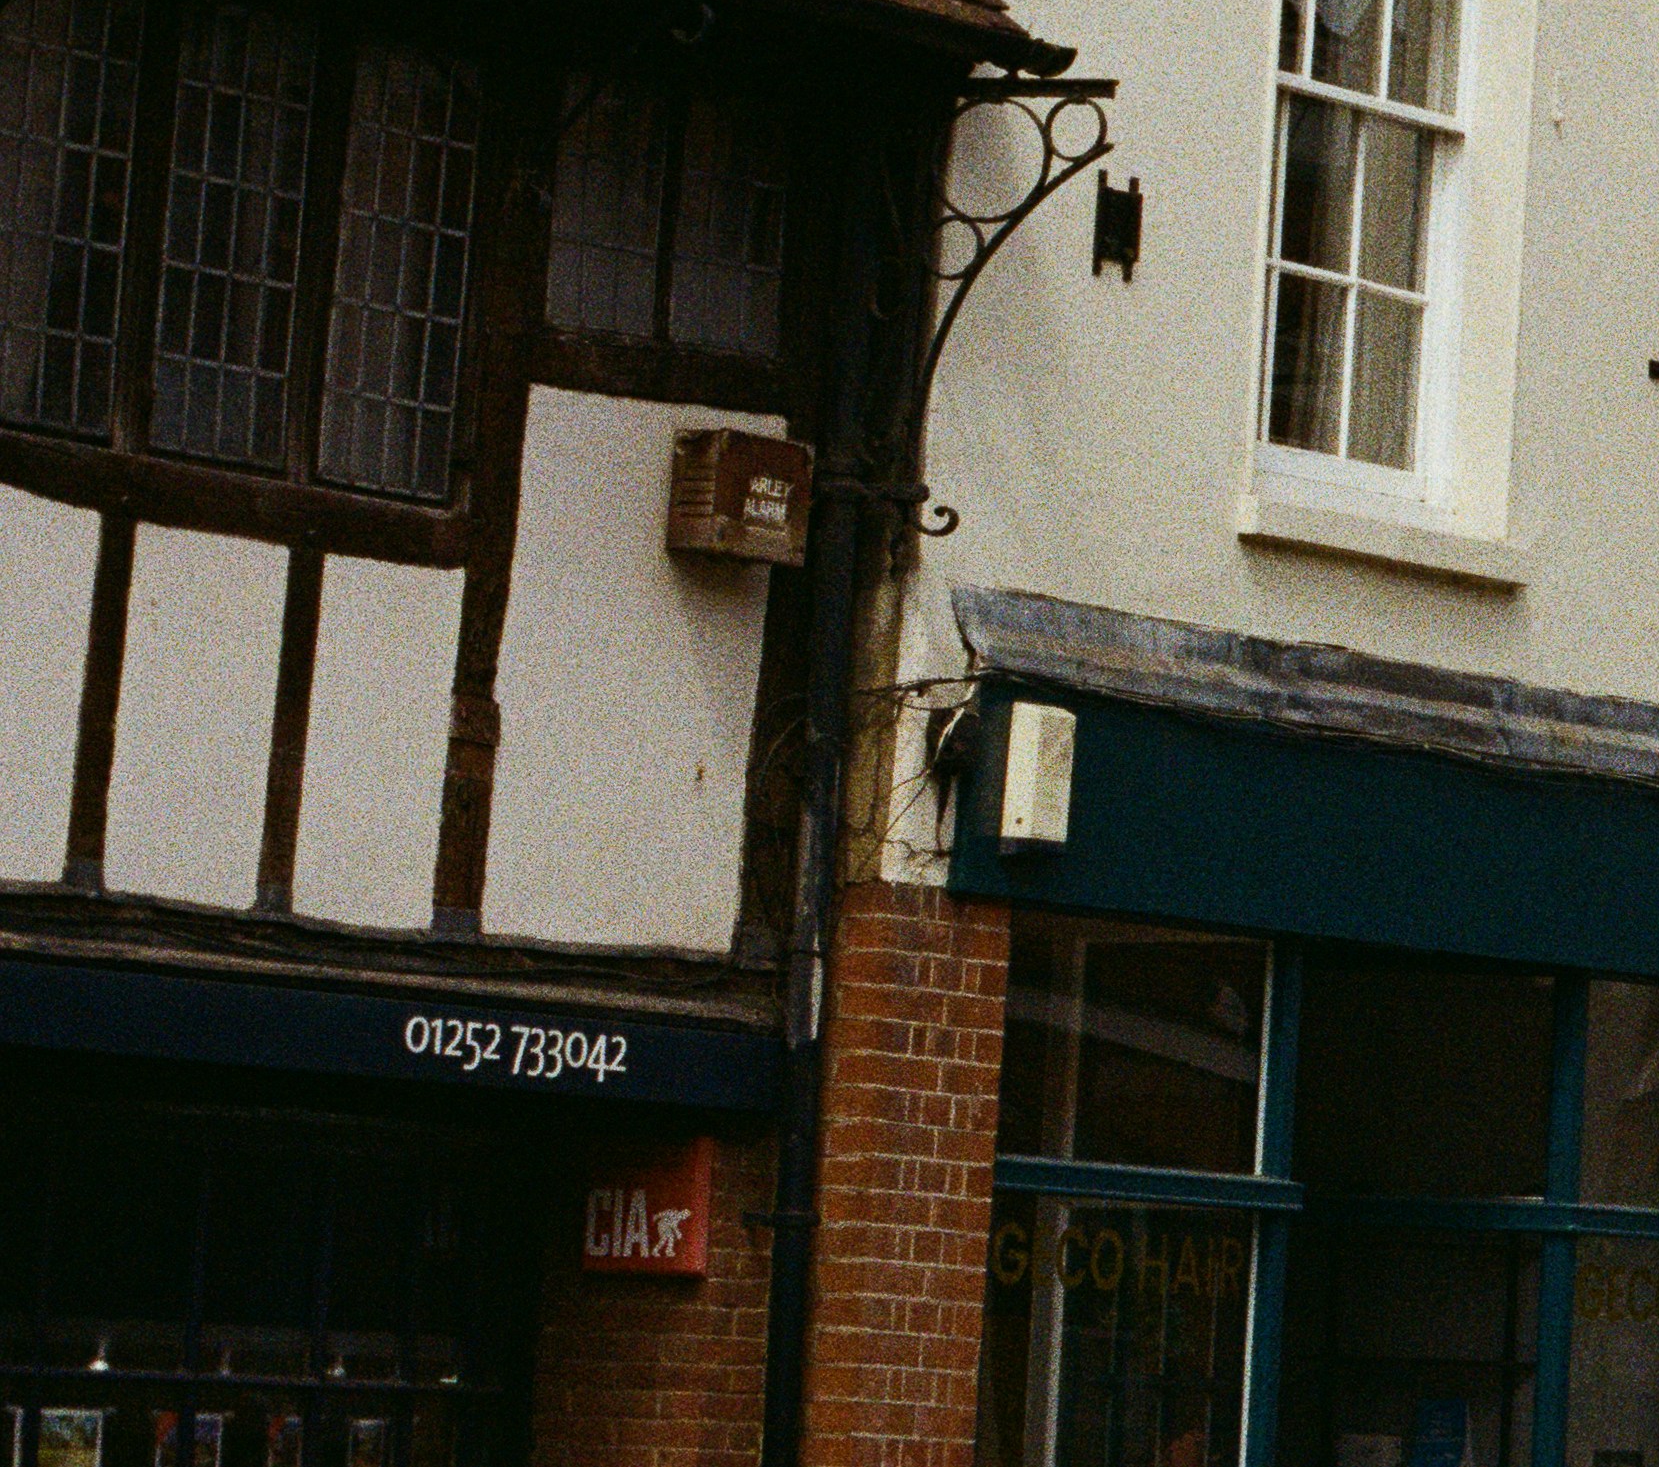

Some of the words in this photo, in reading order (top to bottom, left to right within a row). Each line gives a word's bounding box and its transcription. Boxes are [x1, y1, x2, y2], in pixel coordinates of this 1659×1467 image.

[404, 1016, 502, 1071] 01252
[509, 1025, 629, 1083] 733042
[585, 1187, 651, 1258] CIA
[992, 1222, 1125, 1291] GECO
[1137, 1233, 1244, 1298] HAIR
